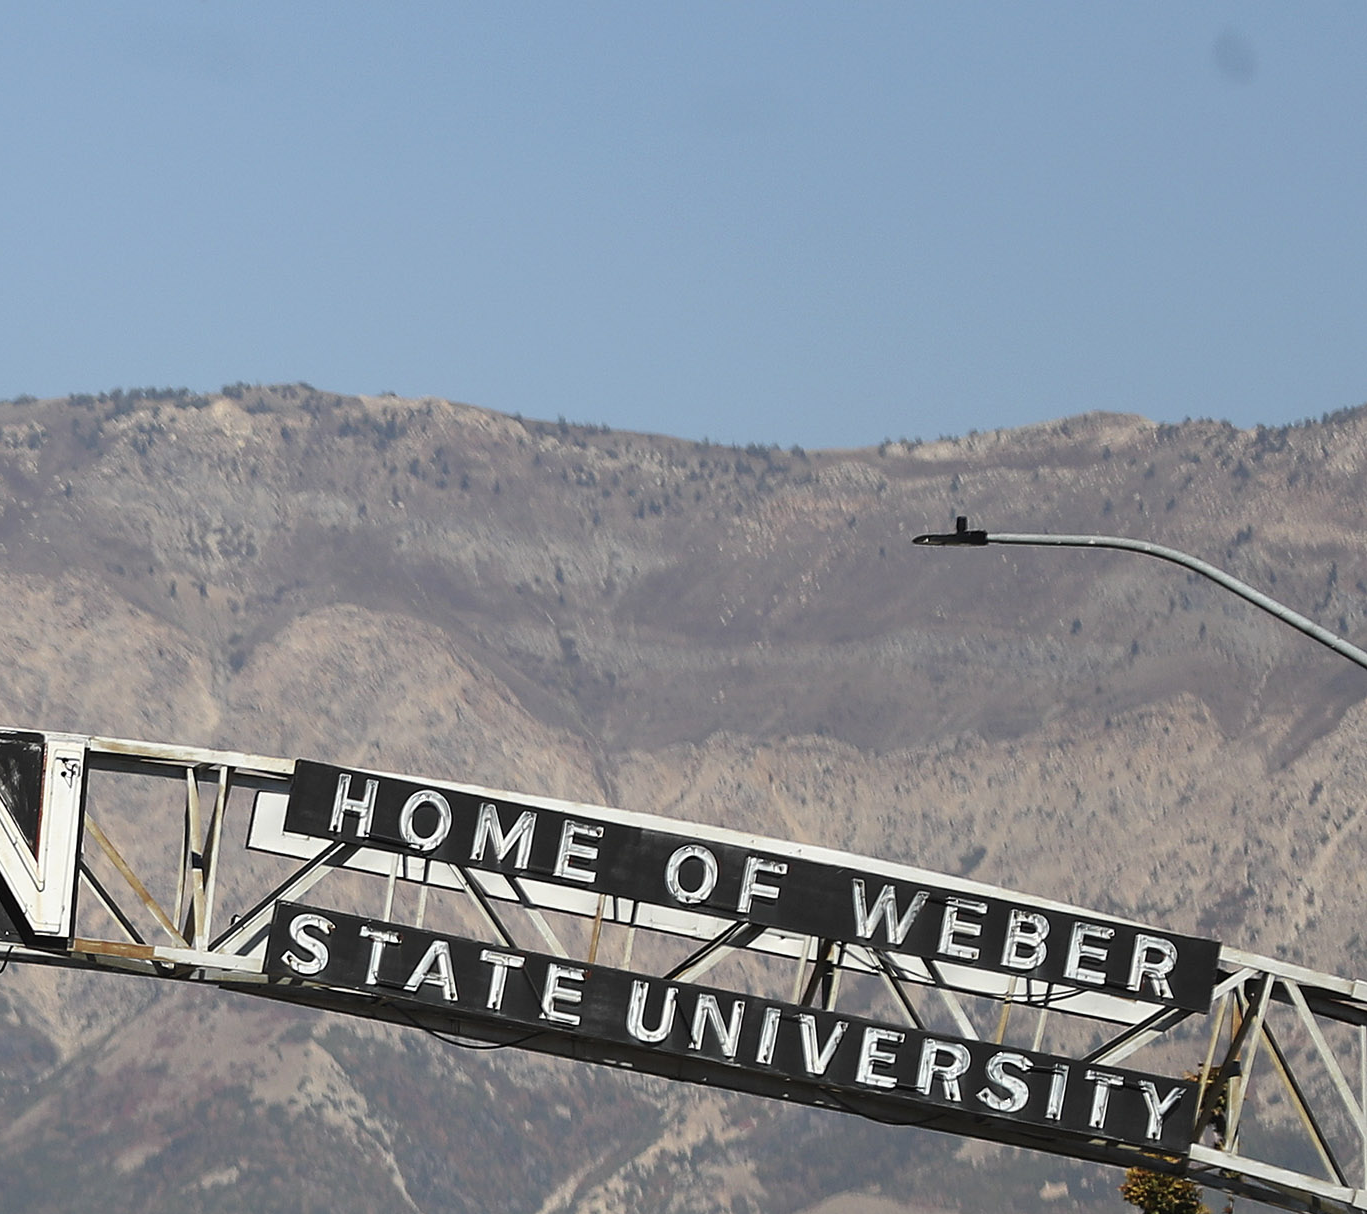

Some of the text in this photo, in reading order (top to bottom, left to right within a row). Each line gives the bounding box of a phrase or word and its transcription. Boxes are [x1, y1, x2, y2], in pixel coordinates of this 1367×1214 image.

[329, 773, 1178, 998] HOME OF WEBER
[280, 913, 1187, 1141] STATE UNIVERSITY
